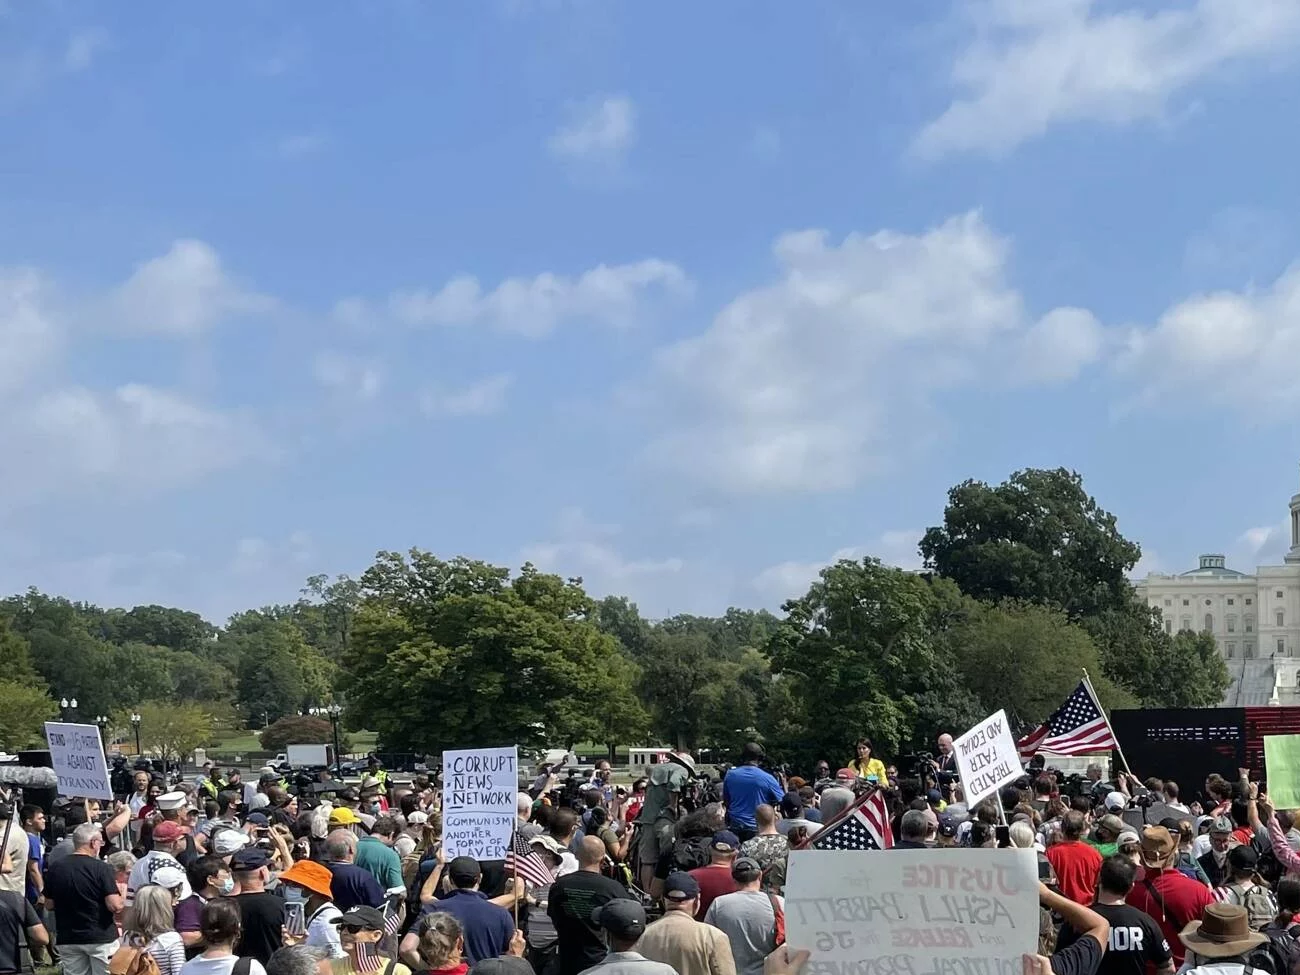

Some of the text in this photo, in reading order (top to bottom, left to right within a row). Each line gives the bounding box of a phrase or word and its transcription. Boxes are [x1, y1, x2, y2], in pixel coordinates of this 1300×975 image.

[959, 718, 1002, 756] AND EQUAL
[67, 754, 96, 771] AGAINST
[453, 756, 516, 774] CORRUPT
[969, 745, 998, 773] FAIR
[57, 775, 106, 791] TYRANNY
[454, 774, 493, 790] NEWS
[969, 760, 1014, 796] TREATED
[453, 791, 512, 807] NETWORK
[446, 816, 511, 827] COMMUNISM
[446, 830, 492, 840] ANOTHER
[456, 838, 503, 849] FORM OF
